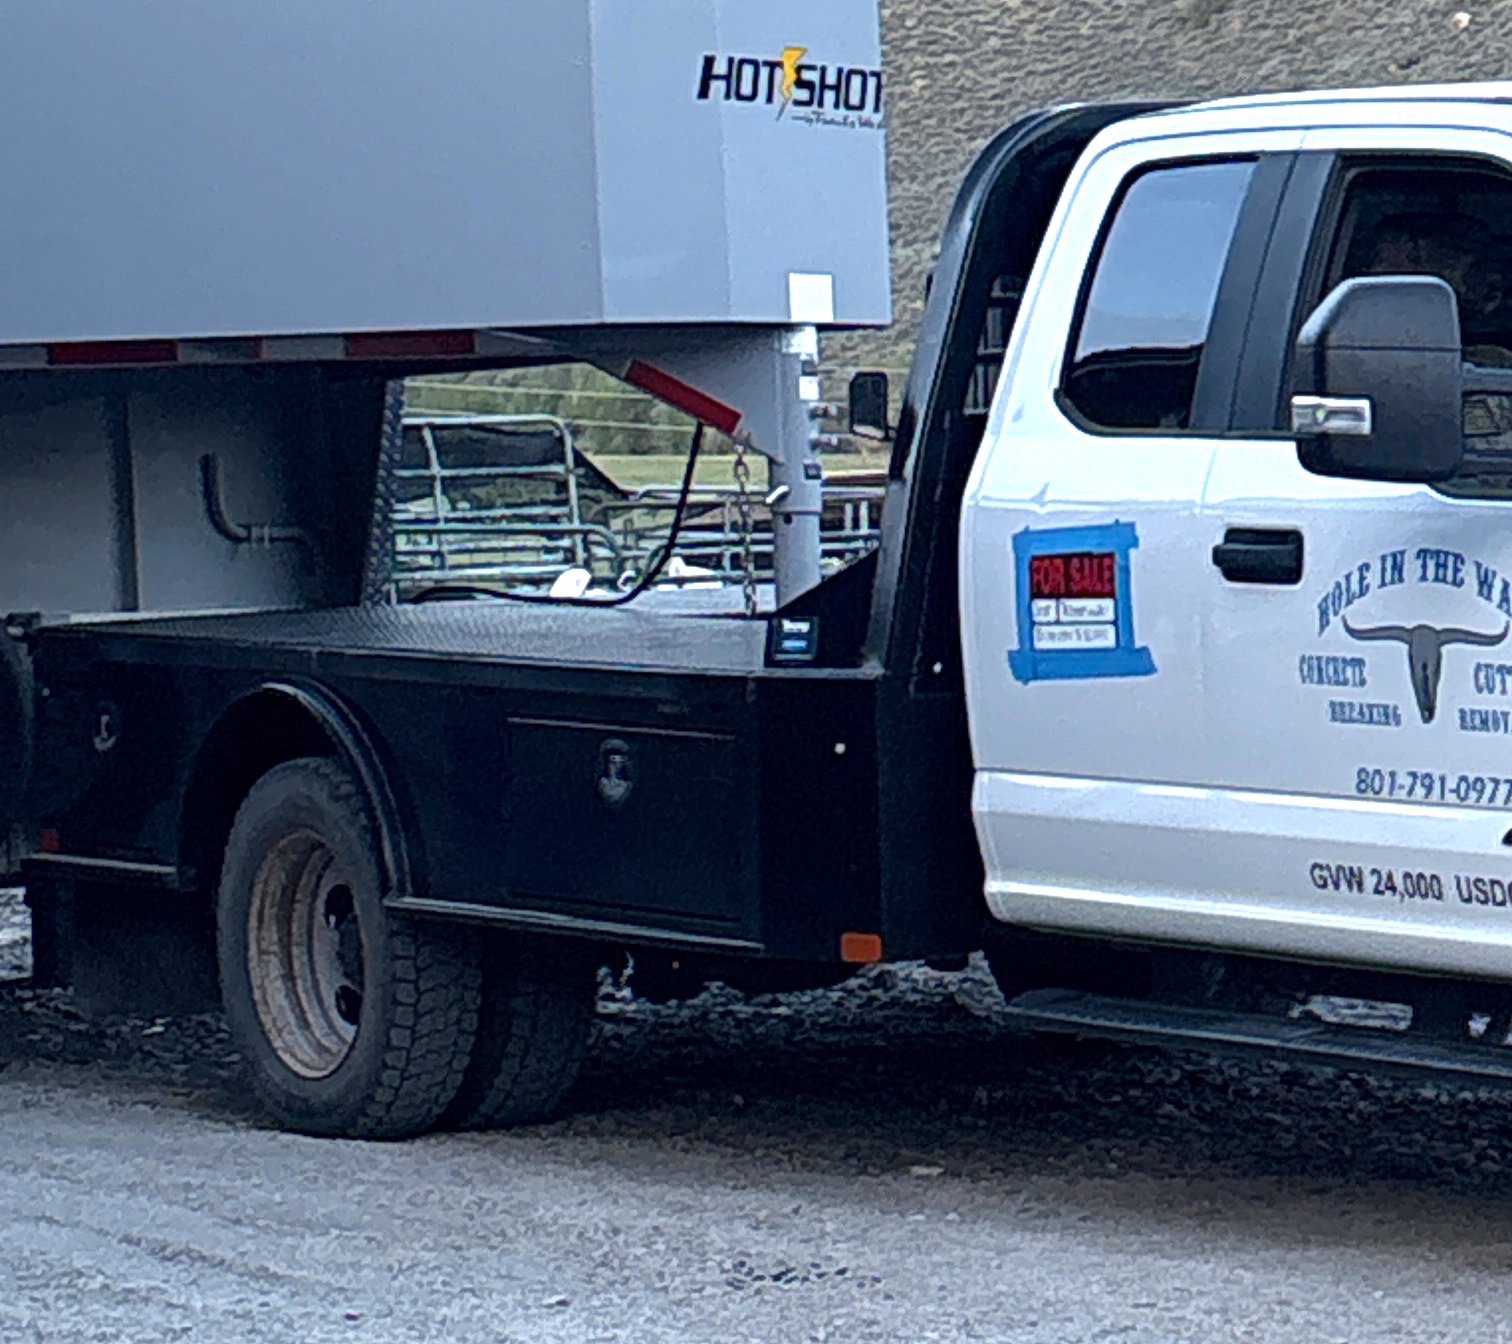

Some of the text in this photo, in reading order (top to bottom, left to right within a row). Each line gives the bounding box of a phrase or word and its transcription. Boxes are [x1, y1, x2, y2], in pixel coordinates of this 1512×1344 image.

[697, 55, 782, 104] HOT
[1032, 556, 1115, 595] FOR SALE
[1317, 562, 1371, 637] HOLE
[1377, 549, 1407, 590] IN
[1415, 548, 1465, 589] THE
[1309, 862, 1365, 894] GVW
[1370, 867, 1445, 904] 24,000
